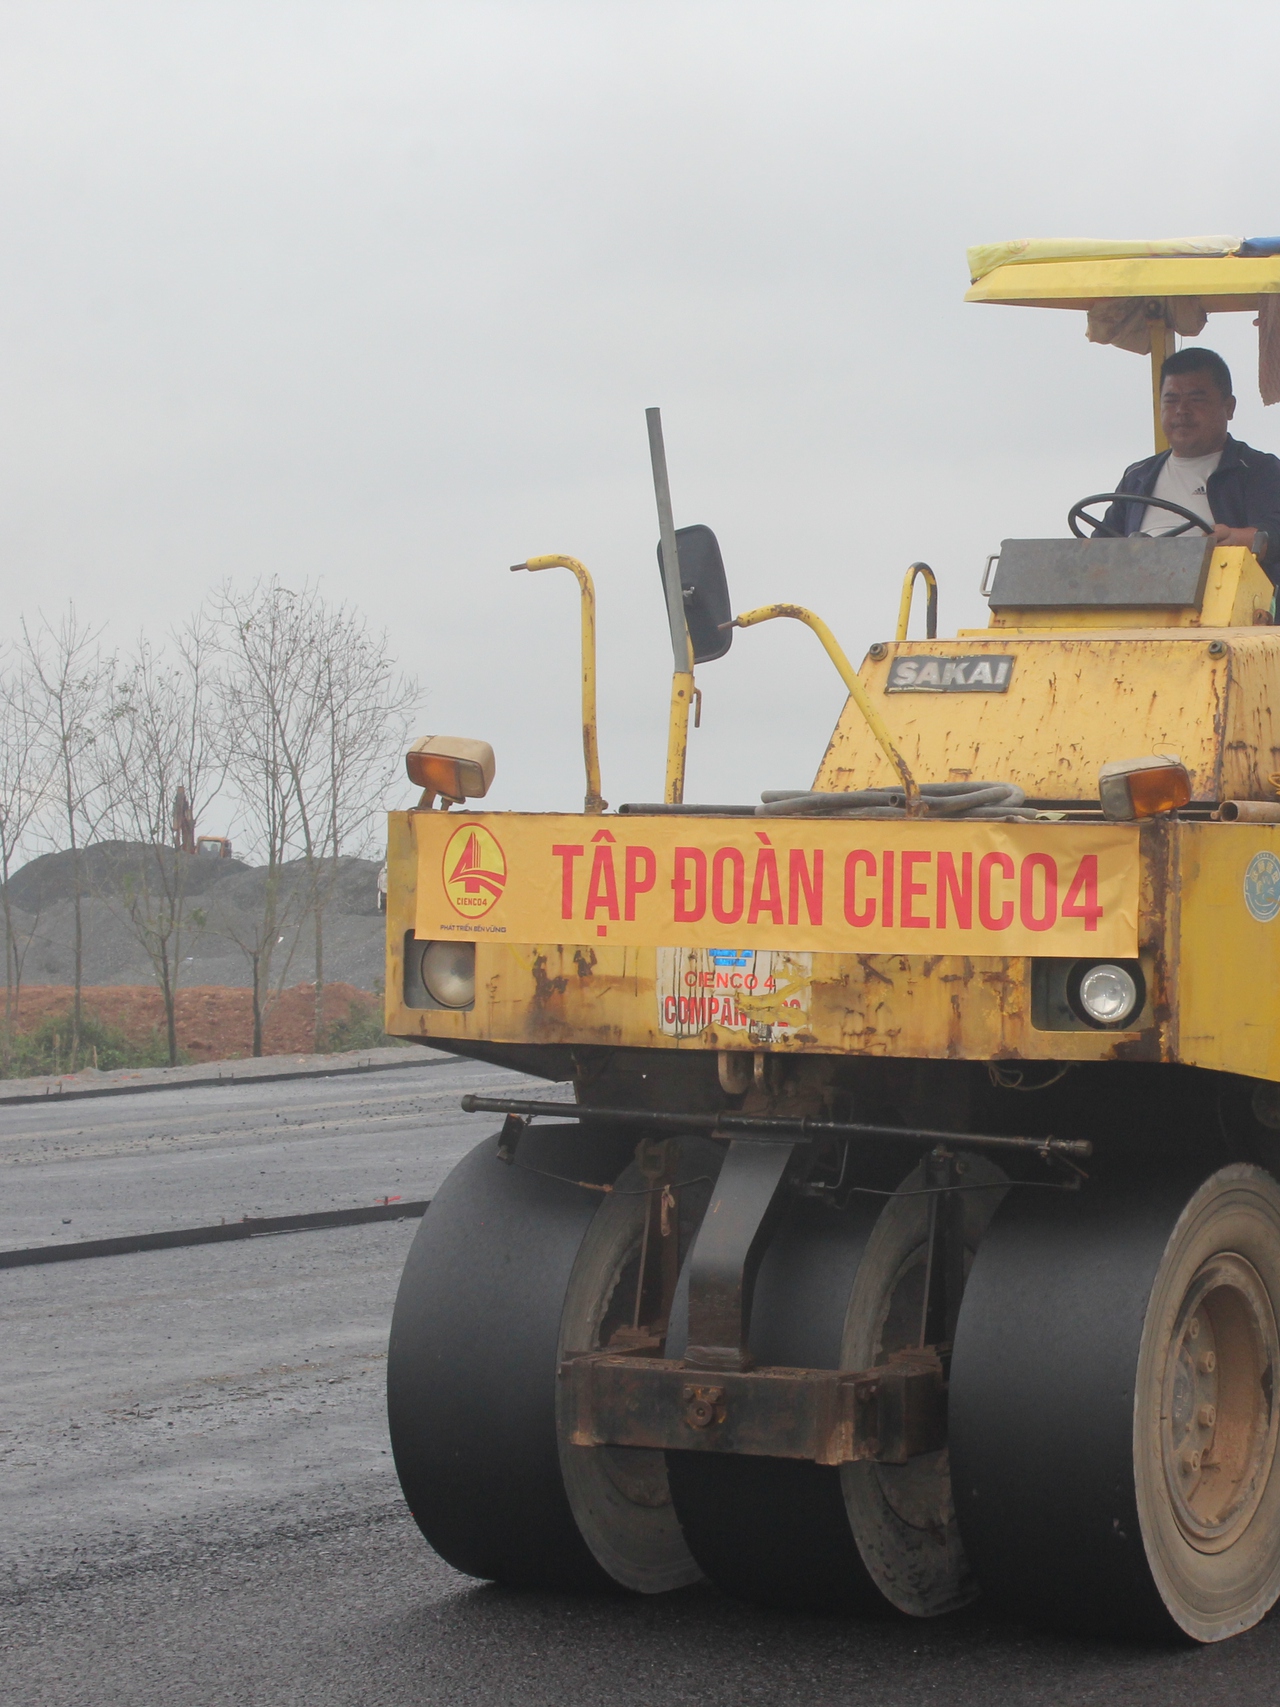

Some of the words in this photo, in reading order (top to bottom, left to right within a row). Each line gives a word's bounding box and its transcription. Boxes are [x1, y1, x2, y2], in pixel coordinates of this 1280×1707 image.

[893, 661, 1010, 686] SAKAI
[552, 829, 657, 937] TẬP
[671, 831, 824, 926] ĐOÀN
[843, 849, 1104, 932] CIENCO4
[457, 897, 487, 906] CIENCO4
[684, 970, 759, 990] CIENCO
[763, 975, 776, 991] 4
[664, 995, 758, 1028] COMPAN
